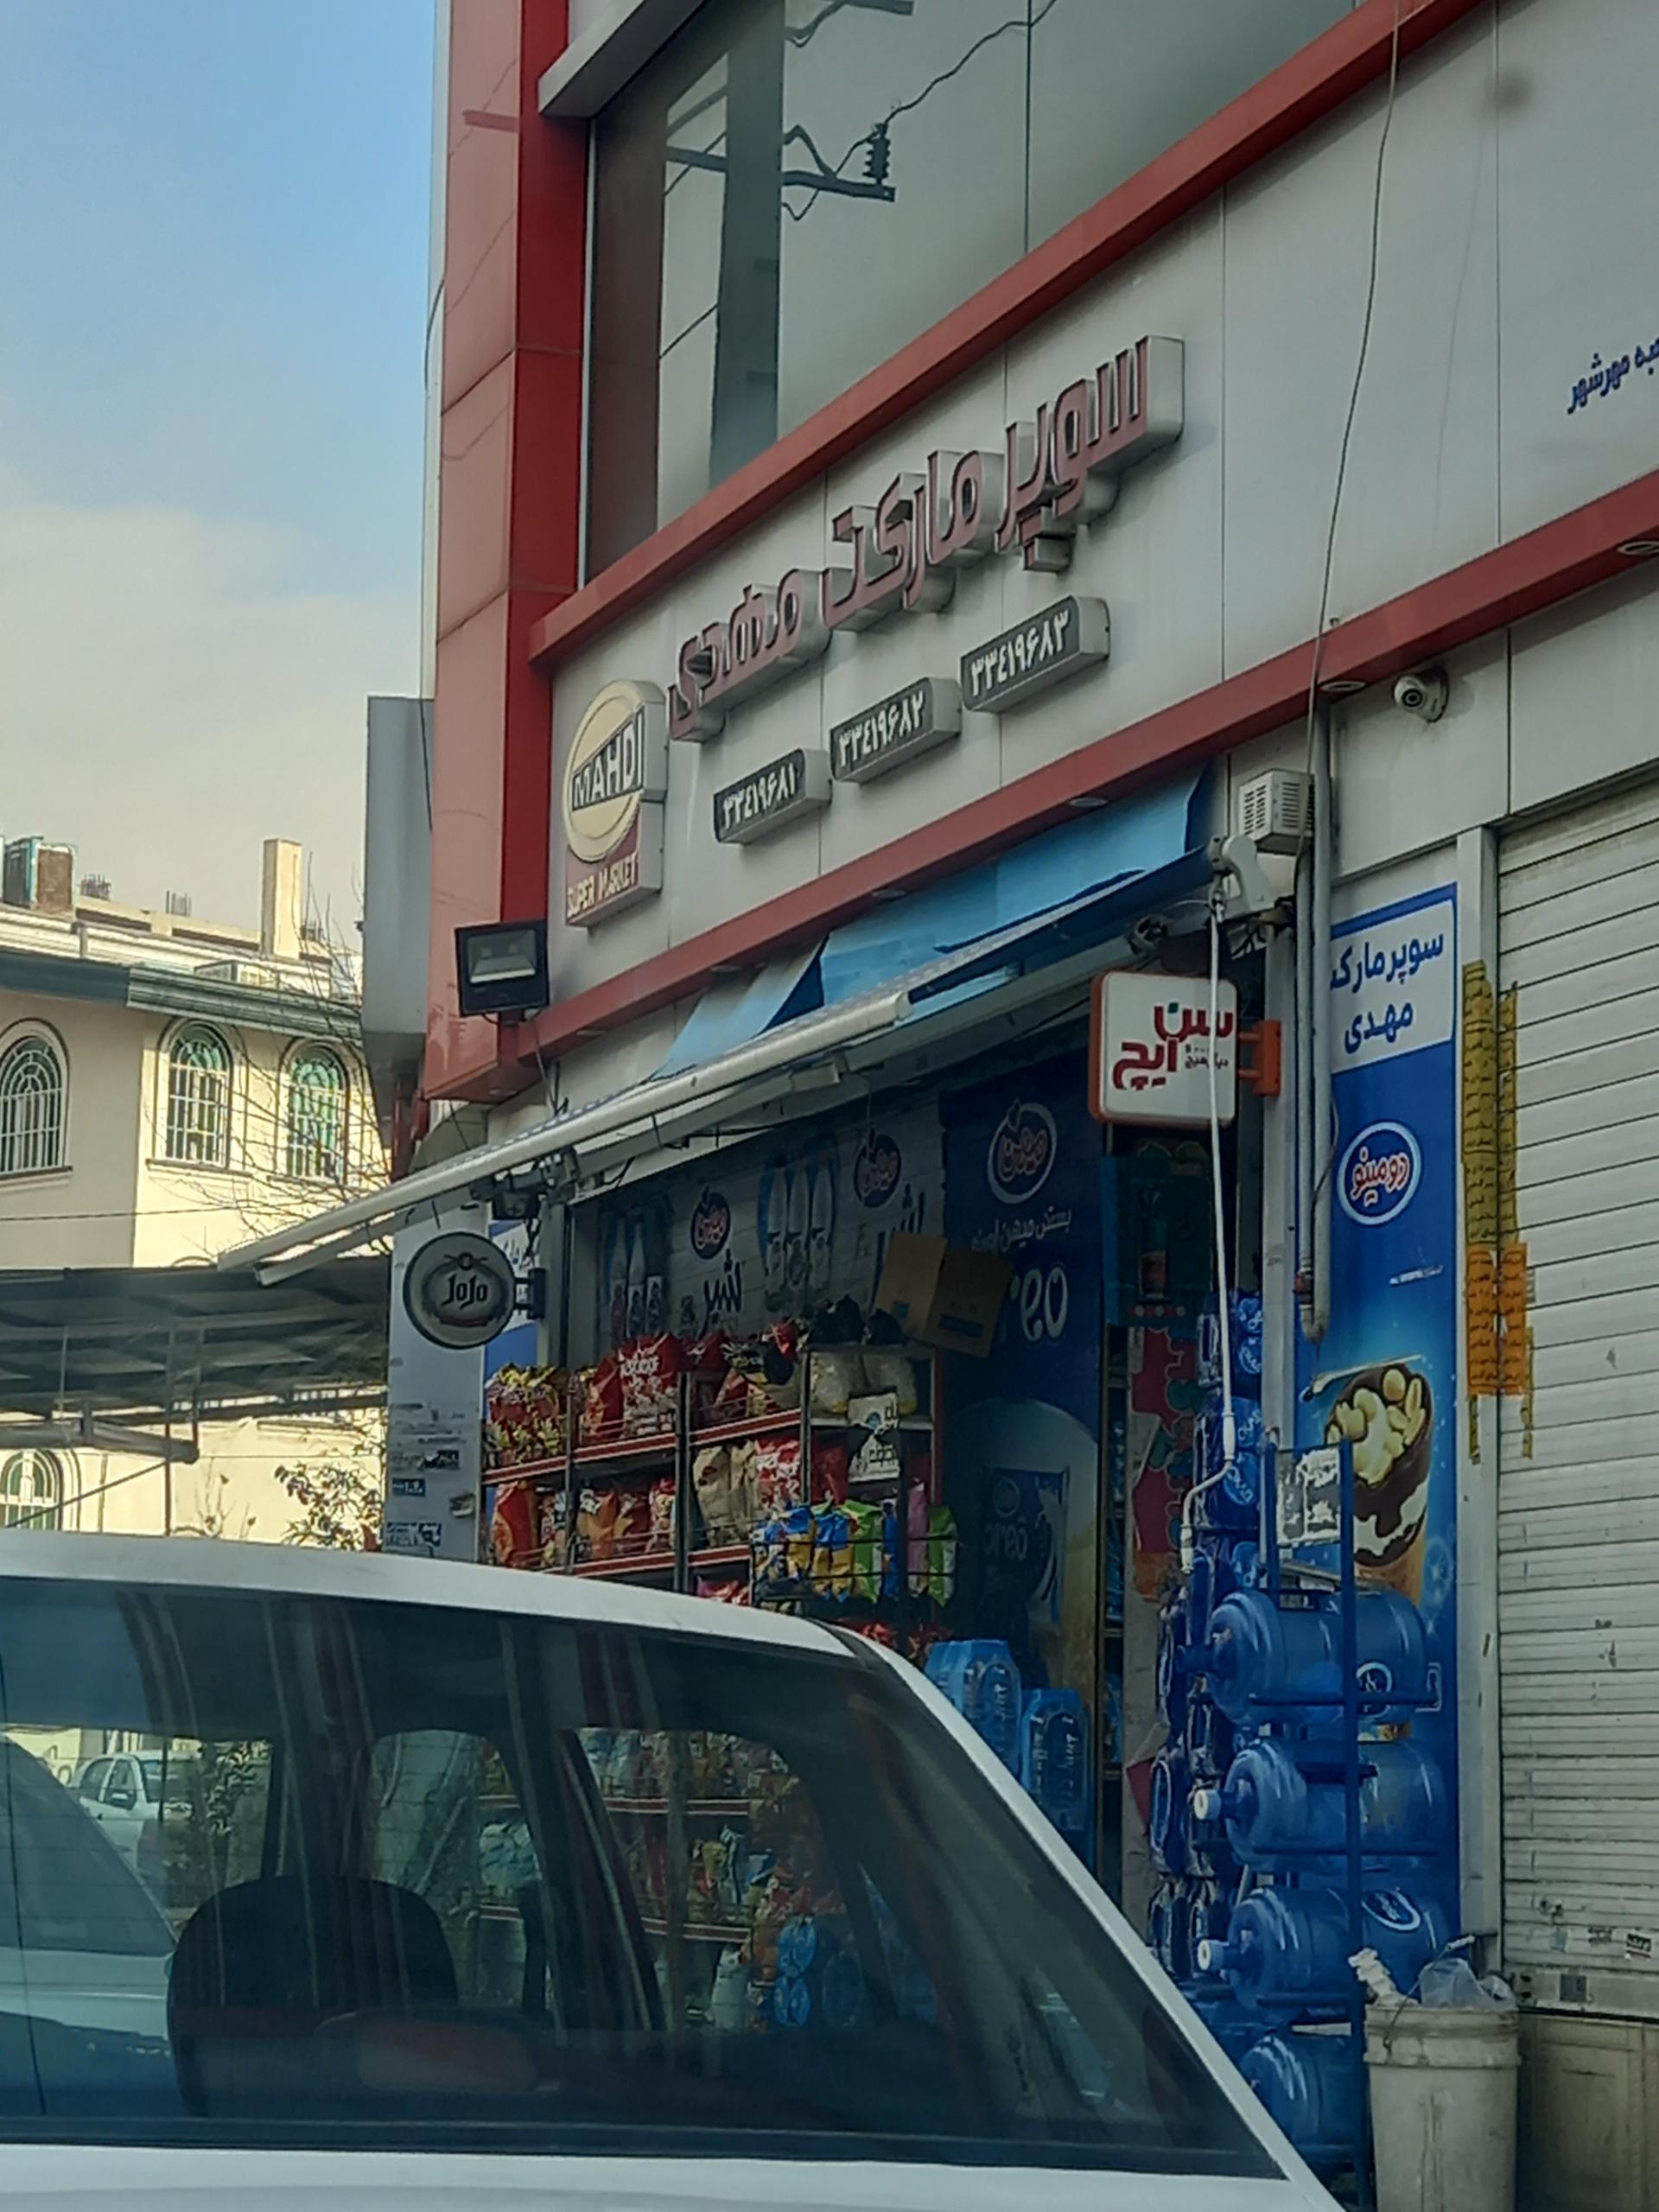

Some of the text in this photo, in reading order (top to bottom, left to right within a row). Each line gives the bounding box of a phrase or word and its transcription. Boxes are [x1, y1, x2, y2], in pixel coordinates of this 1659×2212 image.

[1567, 353, 1630, 415] مهرشهر
[668, 335, 1151, 741] سوپر مارکت مهدی
[574, 712, 644, 808] MAHDI
[567, 851, 638, 918] SUPER MARKET
[1331, 933, 1445, 994] سوپرمارک
[1154, 1001, 1234, 1043] سن
[1344, 1002, 1414, 1055] مهدی
[1111, 1039, 1178, 1091] ایچ
[1350, 1146, 1410, 1207] دومینو
[441, 1273, 488, 1310] JoJo
